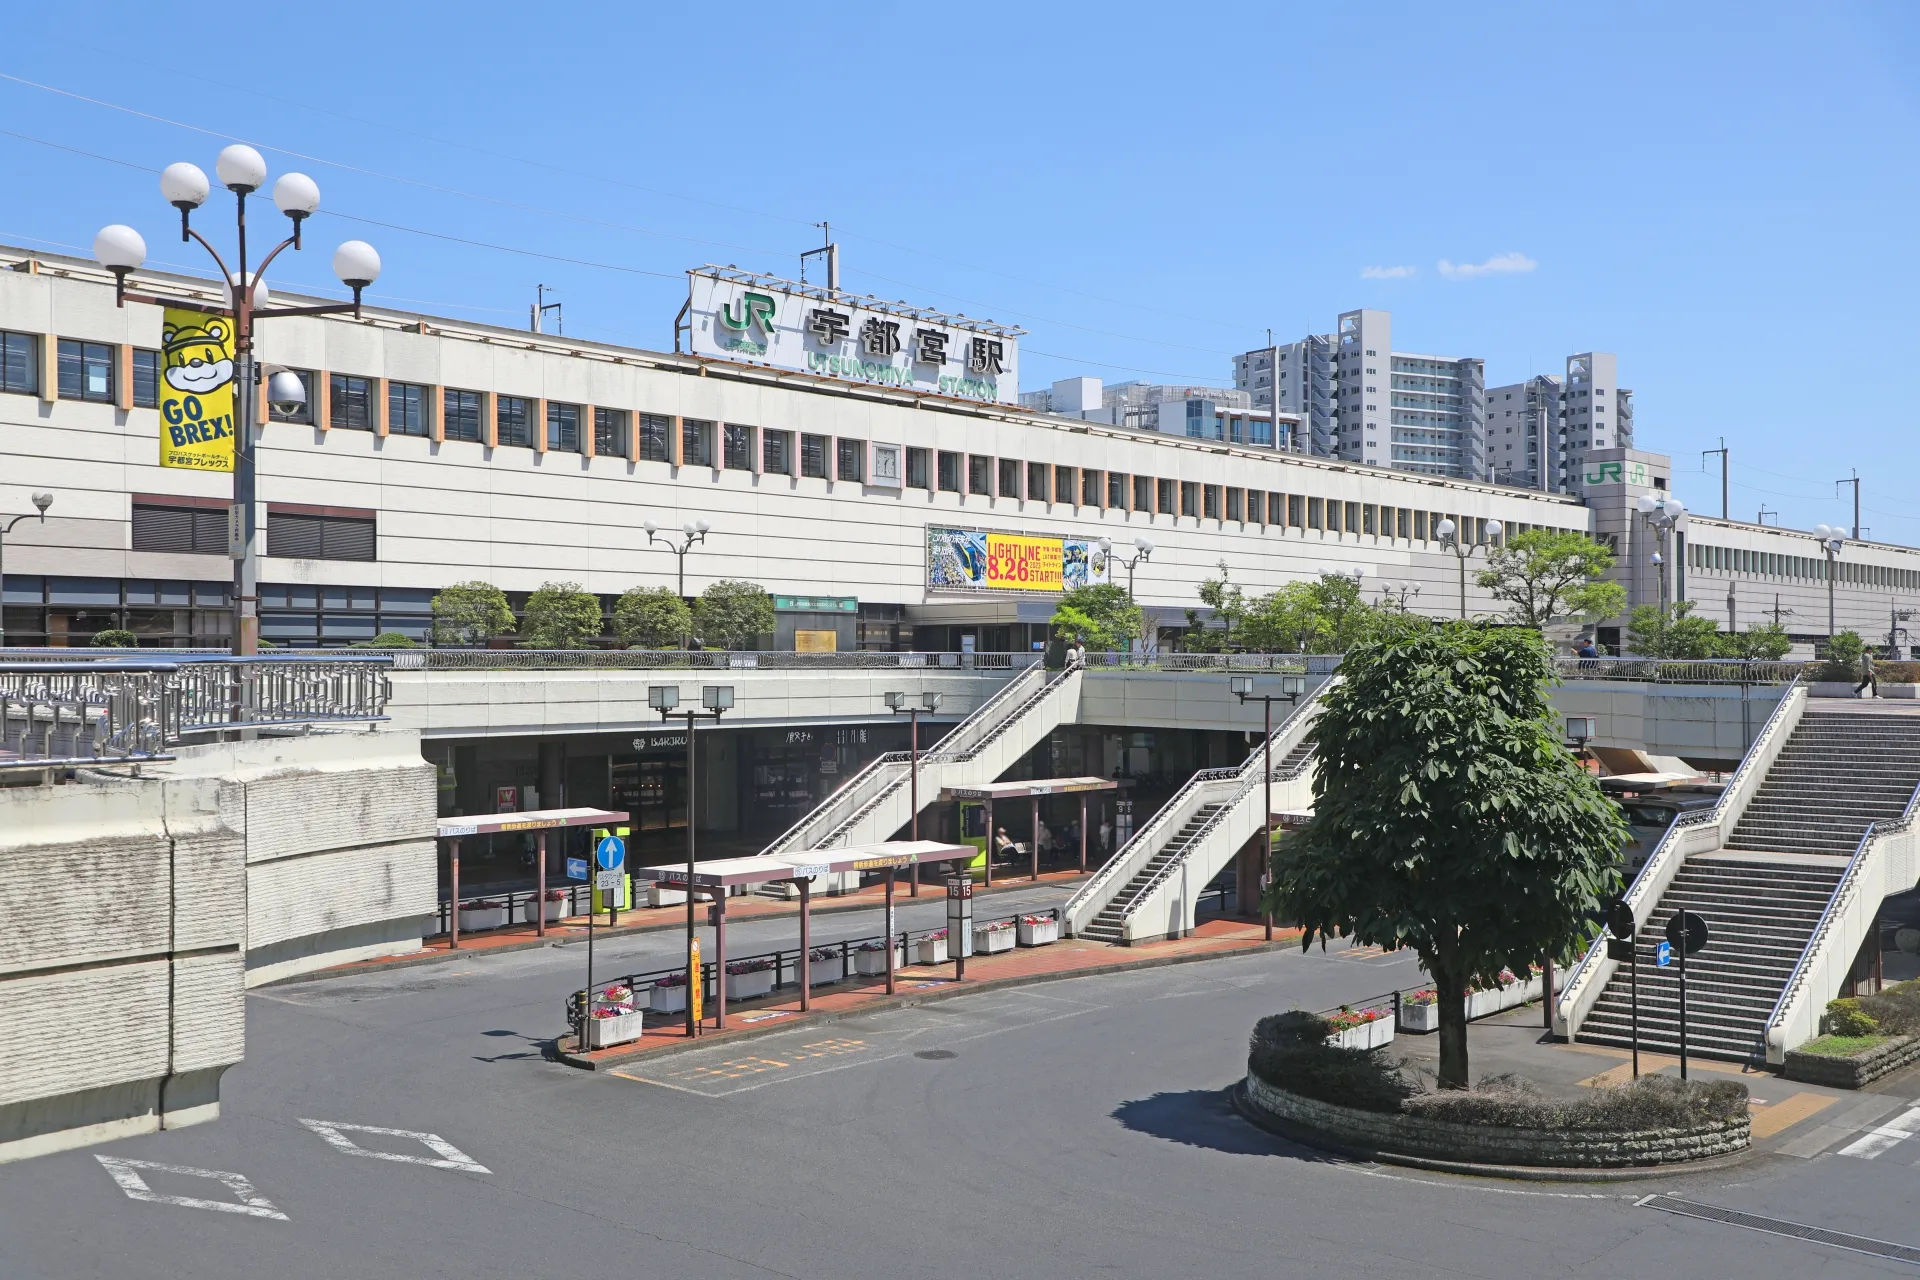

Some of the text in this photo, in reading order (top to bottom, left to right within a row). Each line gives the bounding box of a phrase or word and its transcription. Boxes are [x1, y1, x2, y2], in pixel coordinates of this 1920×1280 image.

[719, 291, 776, 335] JR
[809, 308, 1003, 375] 宇都宮駅
[808, 352, 998, 400] UTSUNOMIYA STATION
[163, 395, 203, 425] GO
[168, 414, 233, 447] BREX!
[168, 456, 229, 468] 宇都宮ブレックス
[1586, 462, 1622, 485] JR
[1630, 464, 1645, 485] JR
[988, 543, 1041, 561] LIGHTLINE
[987, 555, 1029, 582] 8.26
[1030, 570, 1062, 583] START!!!
[958, 789, 982, 797] バスのりば
[449, 826, 476, 834] バスのりば
[669, 872, 702, 883] バスのば
[803, 865, 828, 874] バスのりば
[948, 886, 959, 897] 15
[962, 886, 971, 897] 15
